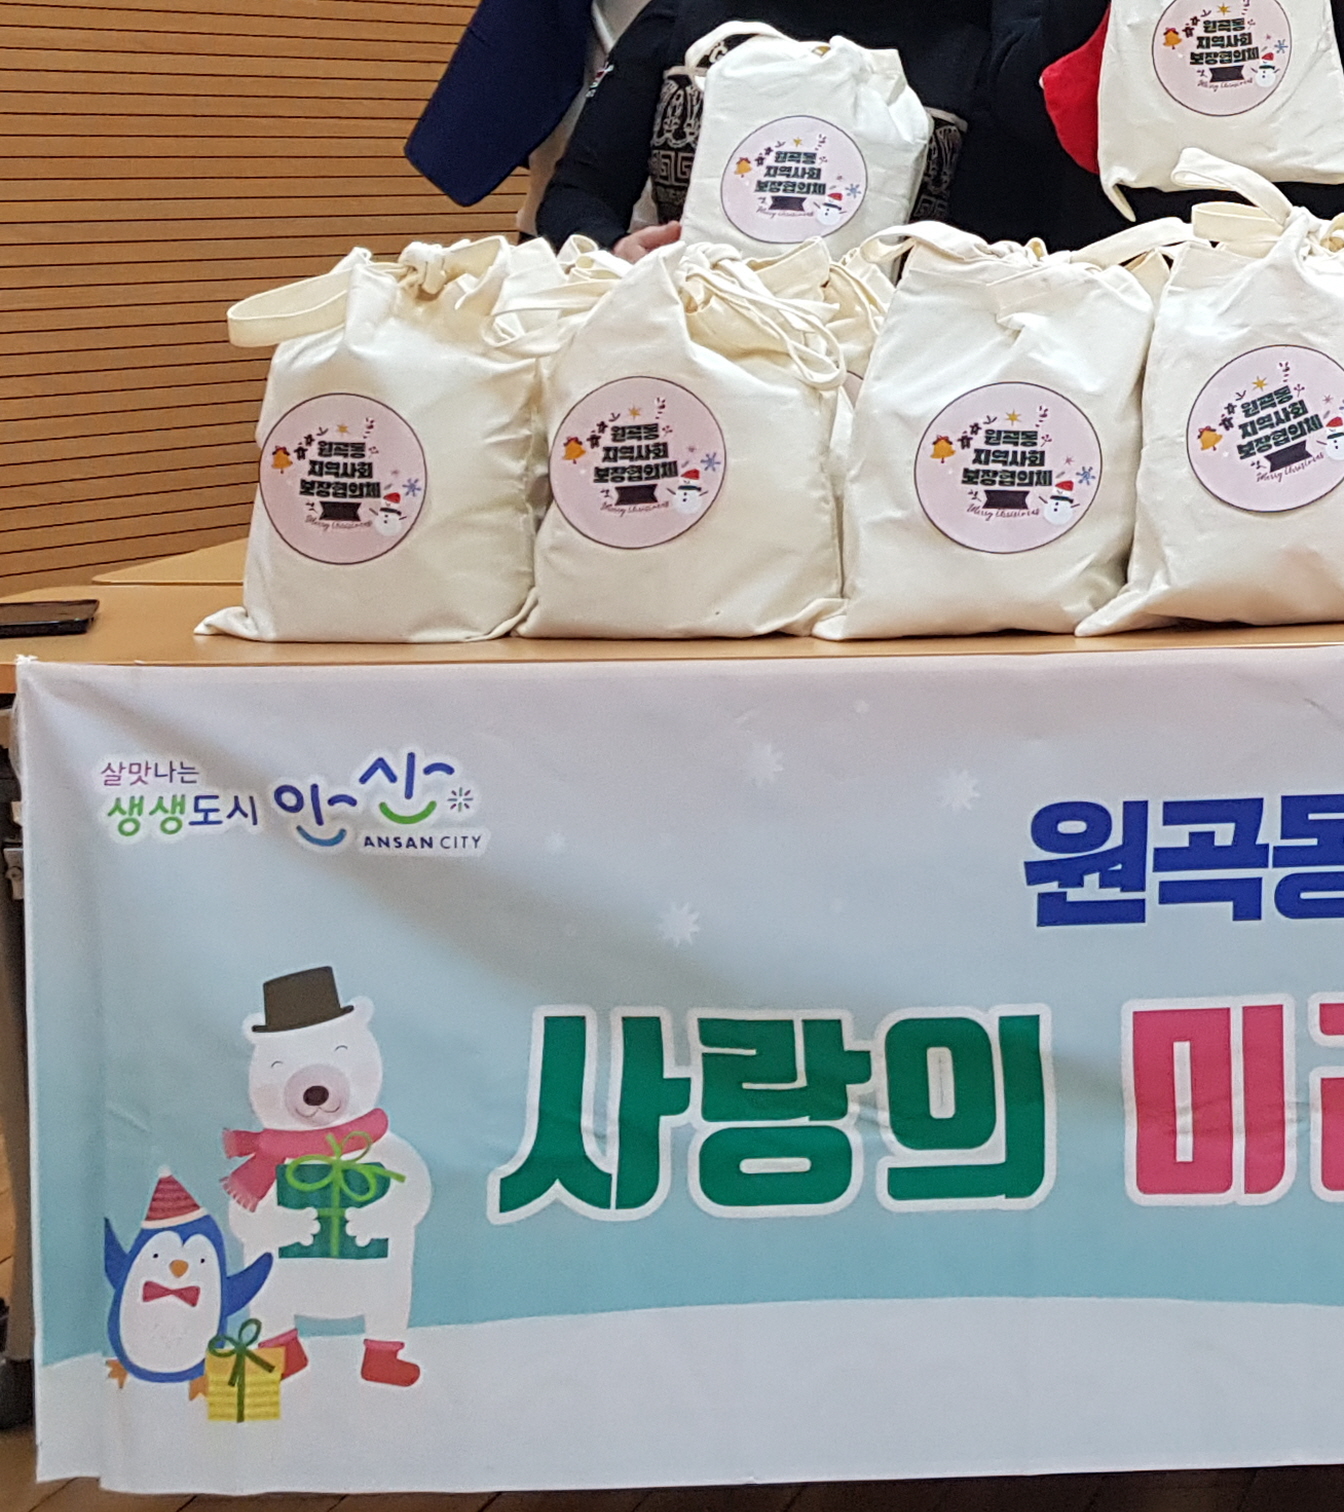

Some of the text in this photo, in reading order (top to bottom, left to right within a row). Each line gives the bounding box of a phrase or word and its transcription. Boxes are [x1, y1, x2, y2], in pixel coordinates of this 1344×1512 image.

[1241, 385, 1293, 418] 원곡동
[1238, 399, 1308, 439] 지역사회
[984, 429, 1038, 447] 원곡동
[1236, 414, 1323, 460] 보장협의체
[972, 448, 1045, 467] 지역사회
[962, 467, 1053, 487] 보장협의체
[100, 760, 200, 786] 살맛나는
[107, 794, 259, 836] 생생도시
[363, 834, 482, 849] ANSAN CITY
[497, 1012, 1046, 1215] 사랑의
